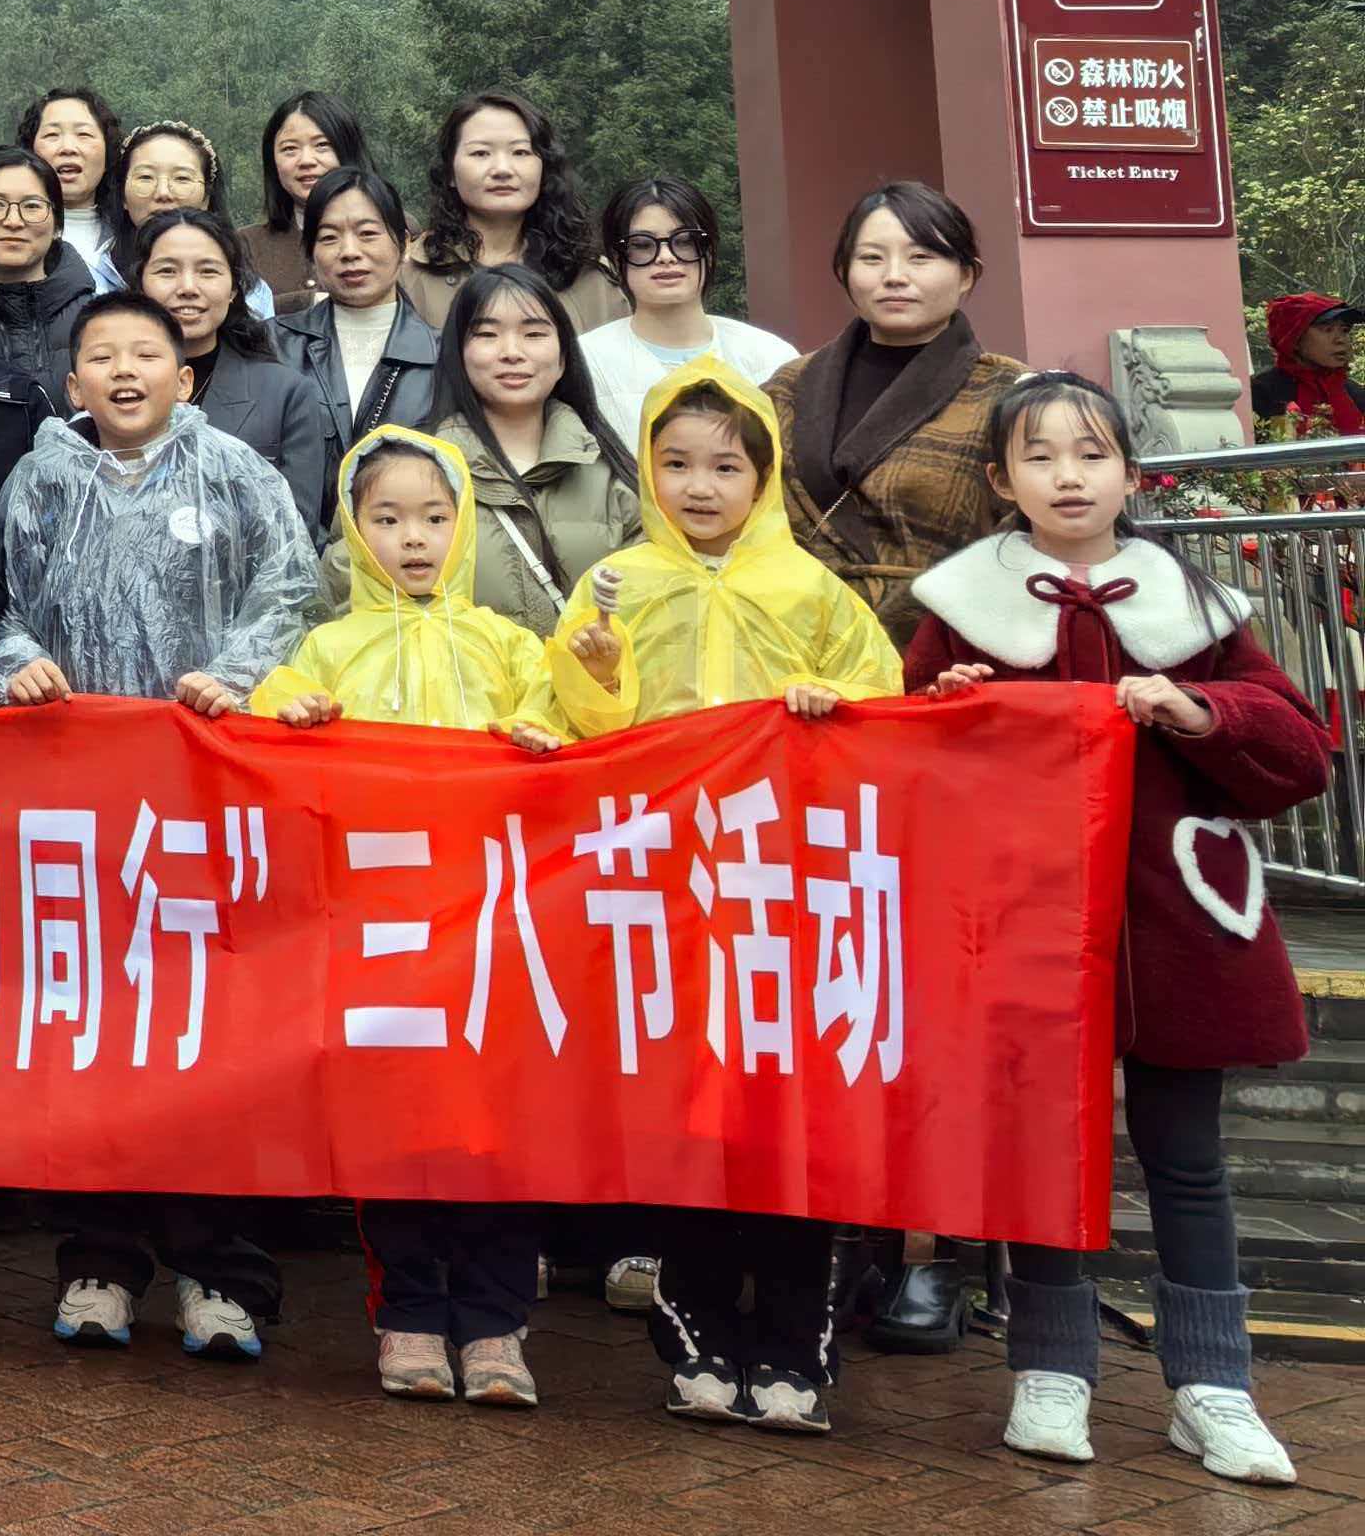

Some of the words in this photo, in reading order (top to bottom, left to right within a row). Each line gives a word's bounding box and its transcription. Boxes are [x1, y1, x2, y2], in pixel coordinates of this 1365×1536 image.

[1079, 57, 1186, 88] 森林防火
[1082, 97, 1187, 129] 禁止吸烟
[1067, 165, 1126, 180] Ticket
[1128, 165, 1179, 181] Entry
